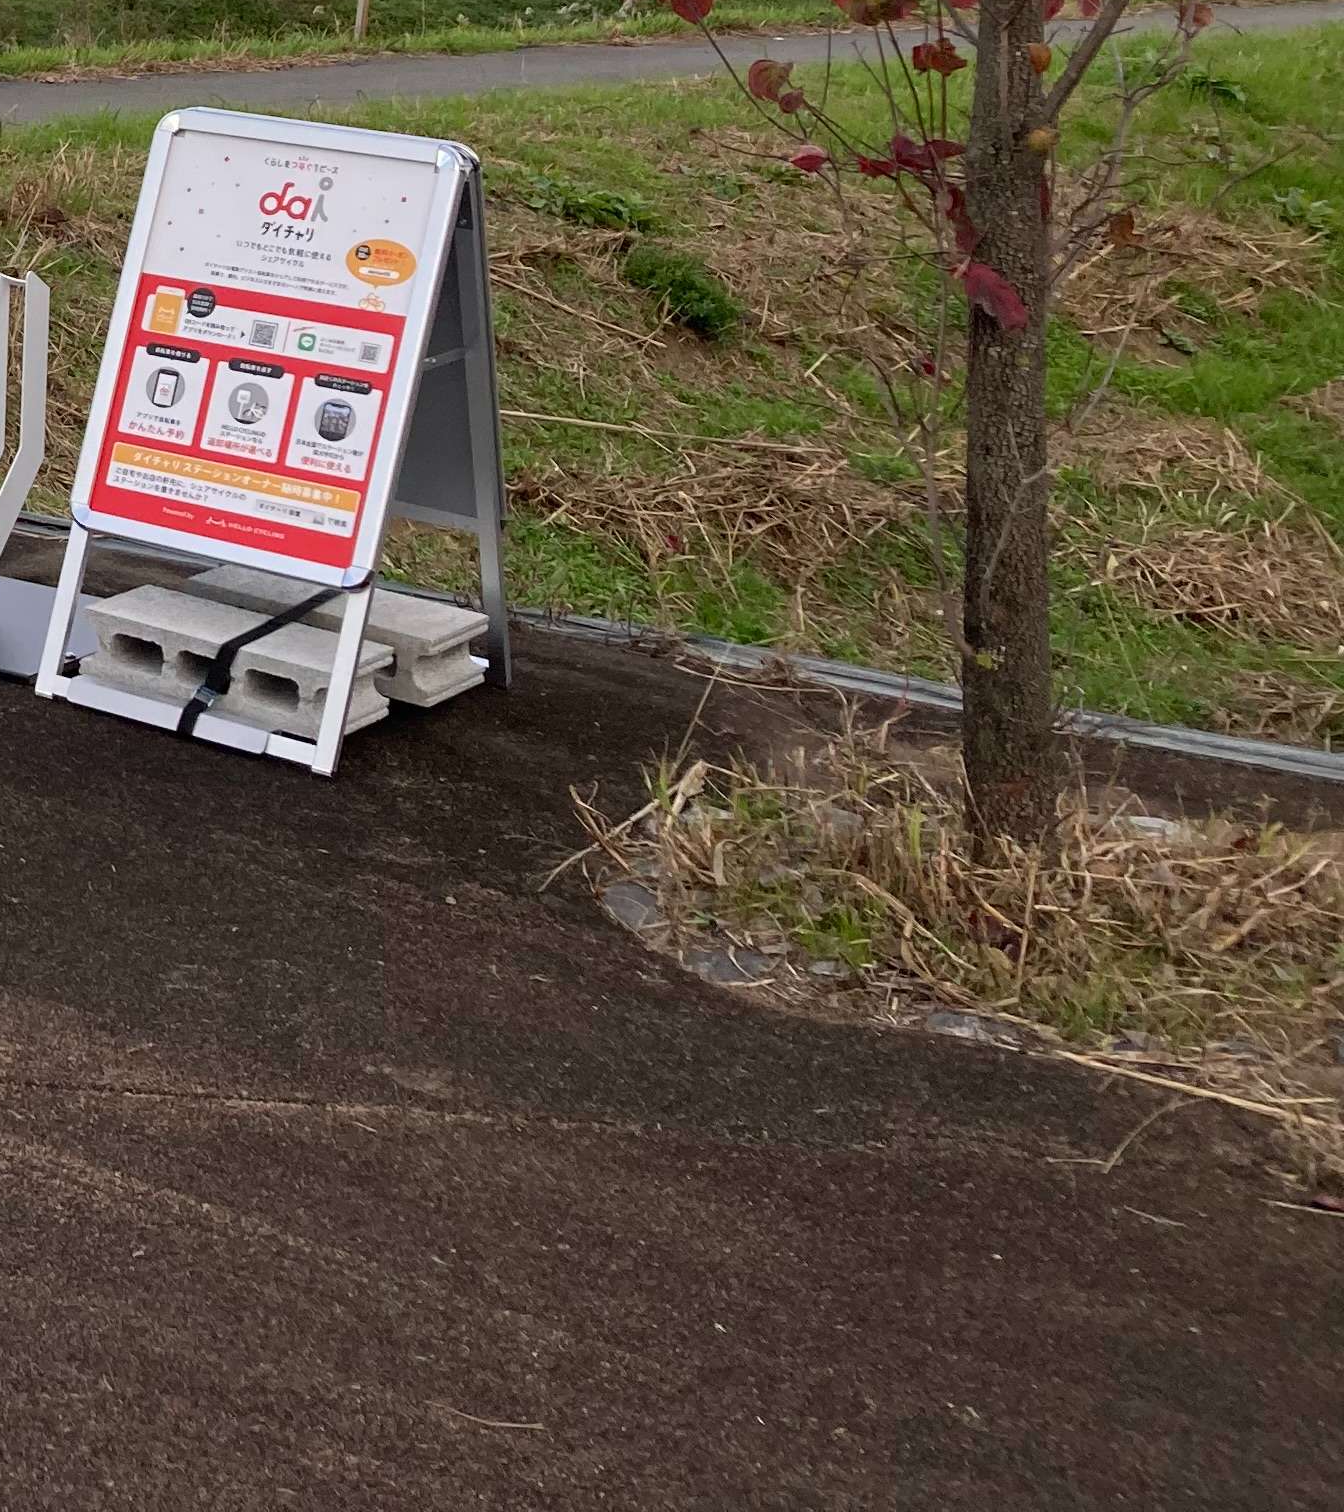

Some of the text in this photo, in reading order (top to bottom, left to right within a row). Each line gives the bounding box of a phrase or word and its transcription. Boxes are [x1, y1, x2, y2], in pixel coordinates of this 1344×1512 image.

[261, 221, 315, 243] ダイチャリ
[128, 420, 185, 440] かんたん予約
[133, 451, 180, 471] ダイチャリ
